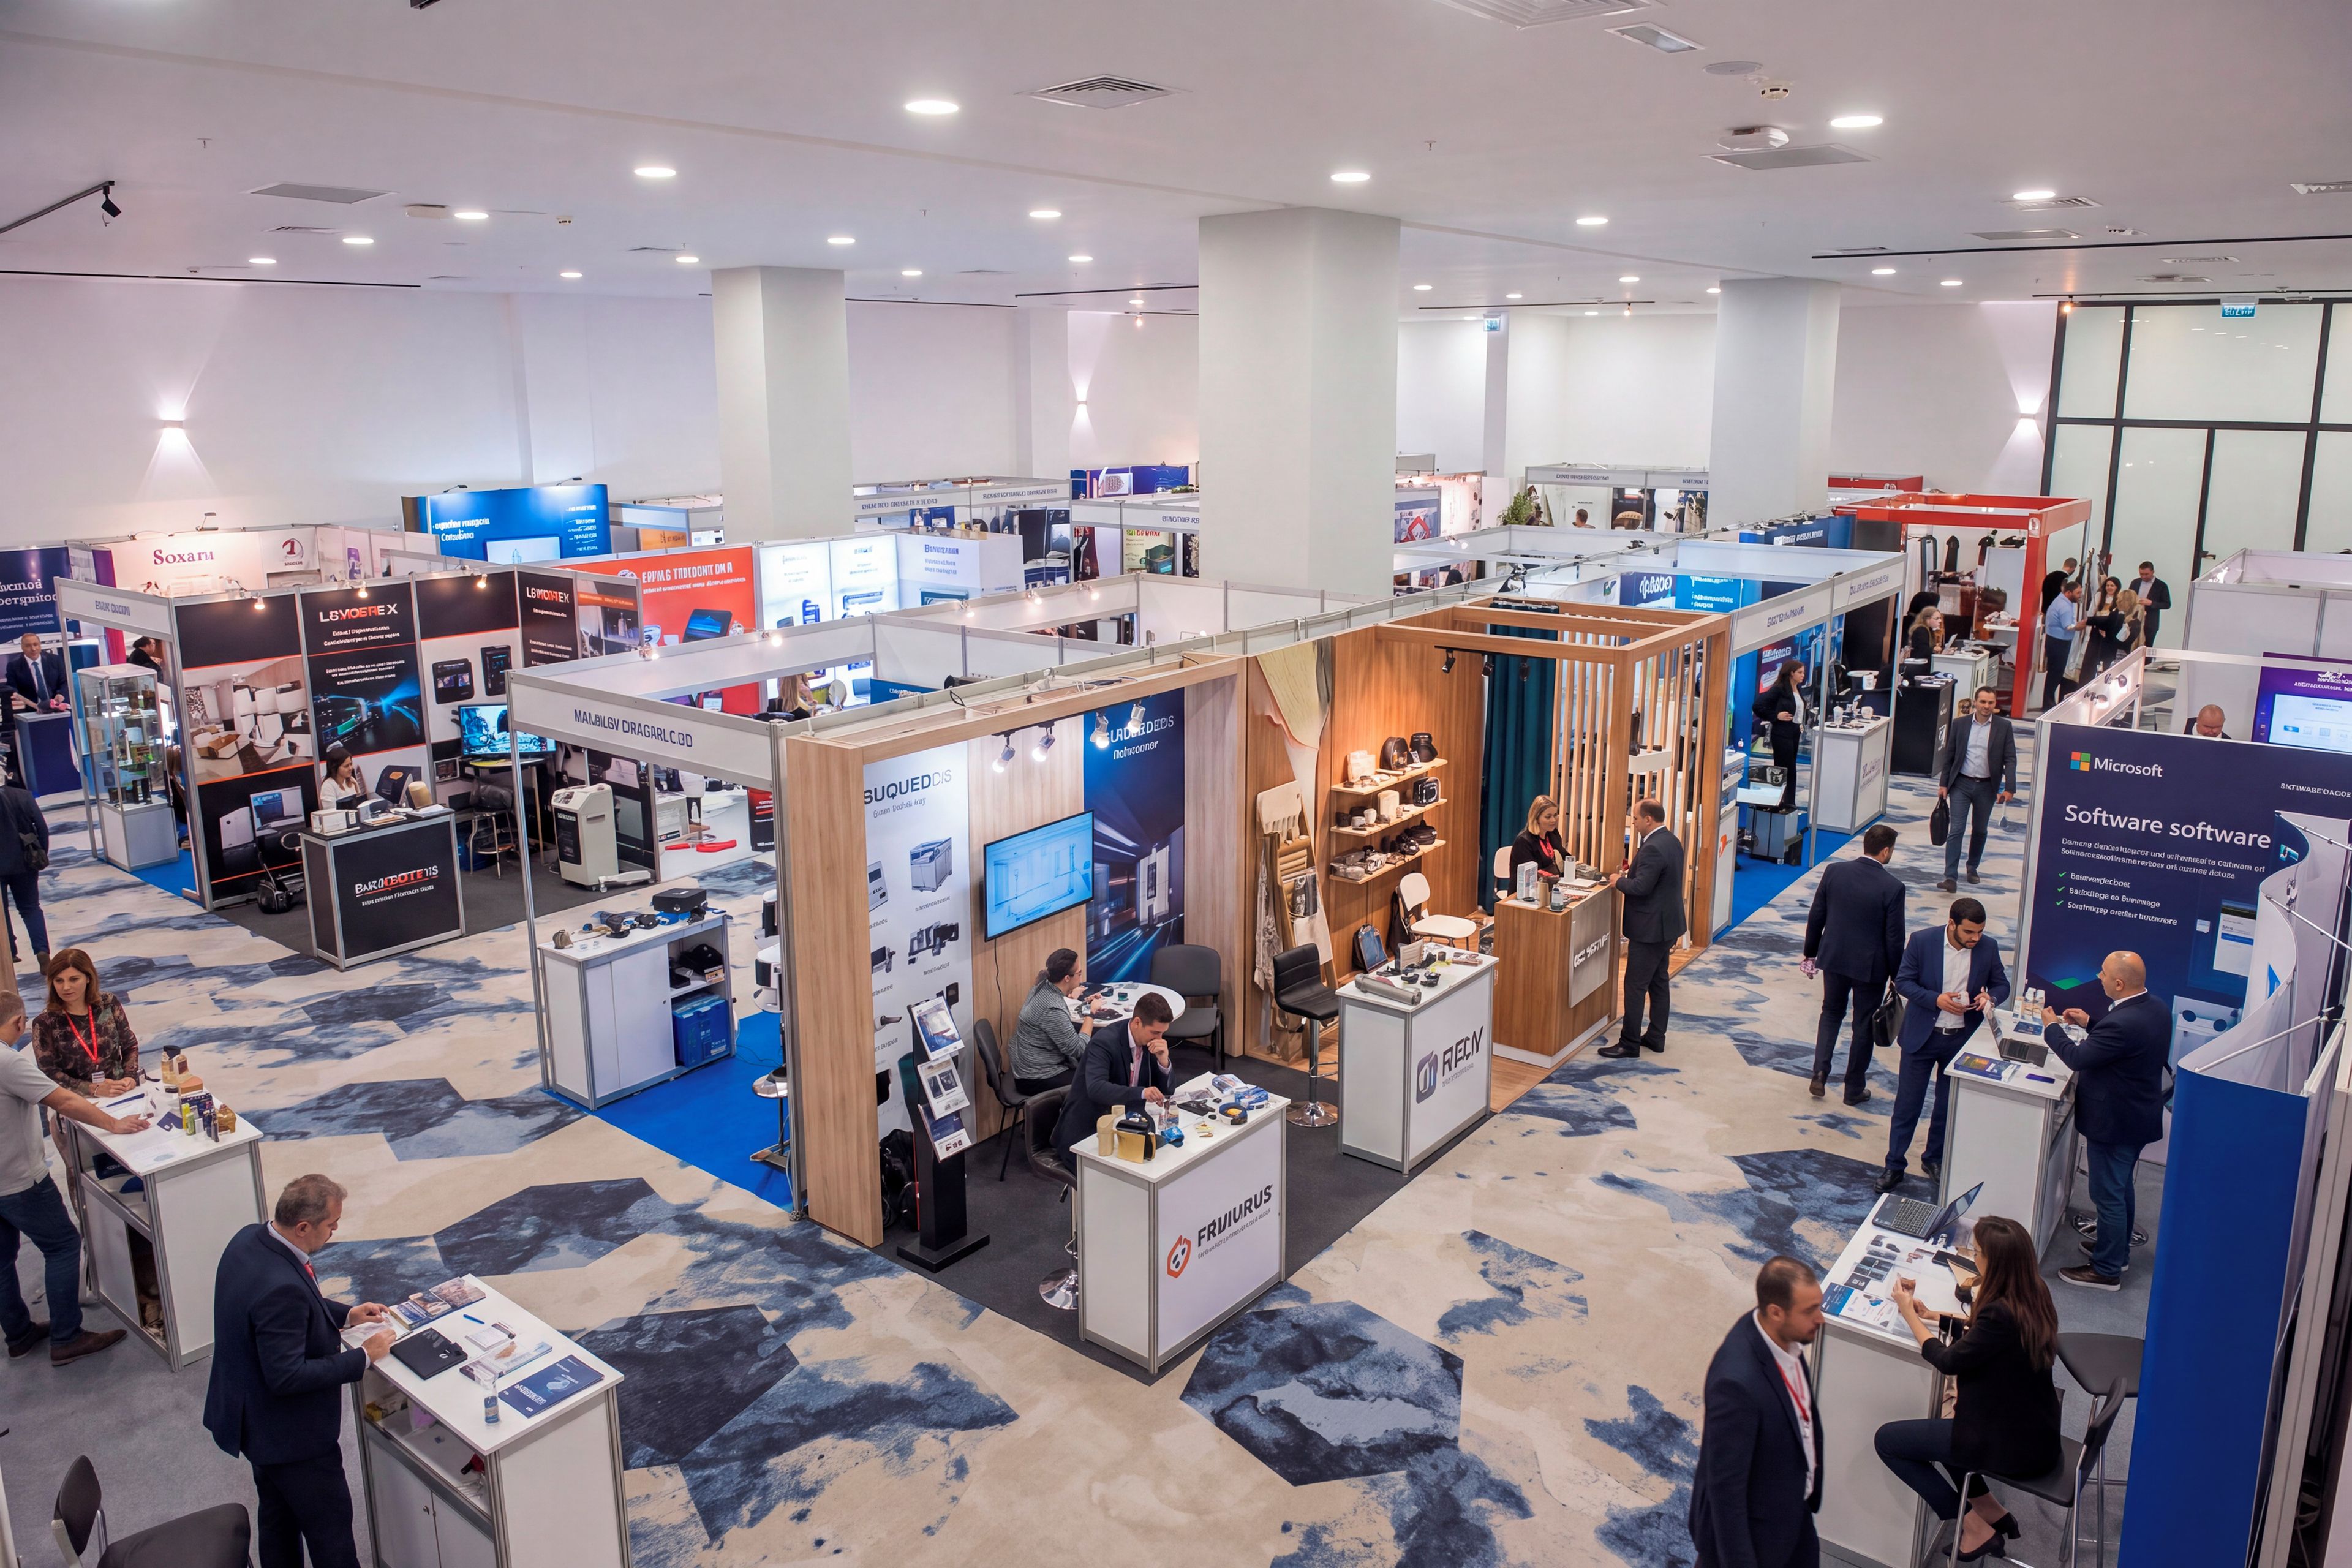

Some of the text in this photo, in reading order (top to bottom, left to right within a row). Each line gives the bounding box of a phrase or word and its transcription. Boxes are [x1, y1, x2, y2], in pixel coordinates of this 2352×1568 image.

[2094, 758, 2163, 777] Microsoft
[2064, 805, 2271, 849] Software software
